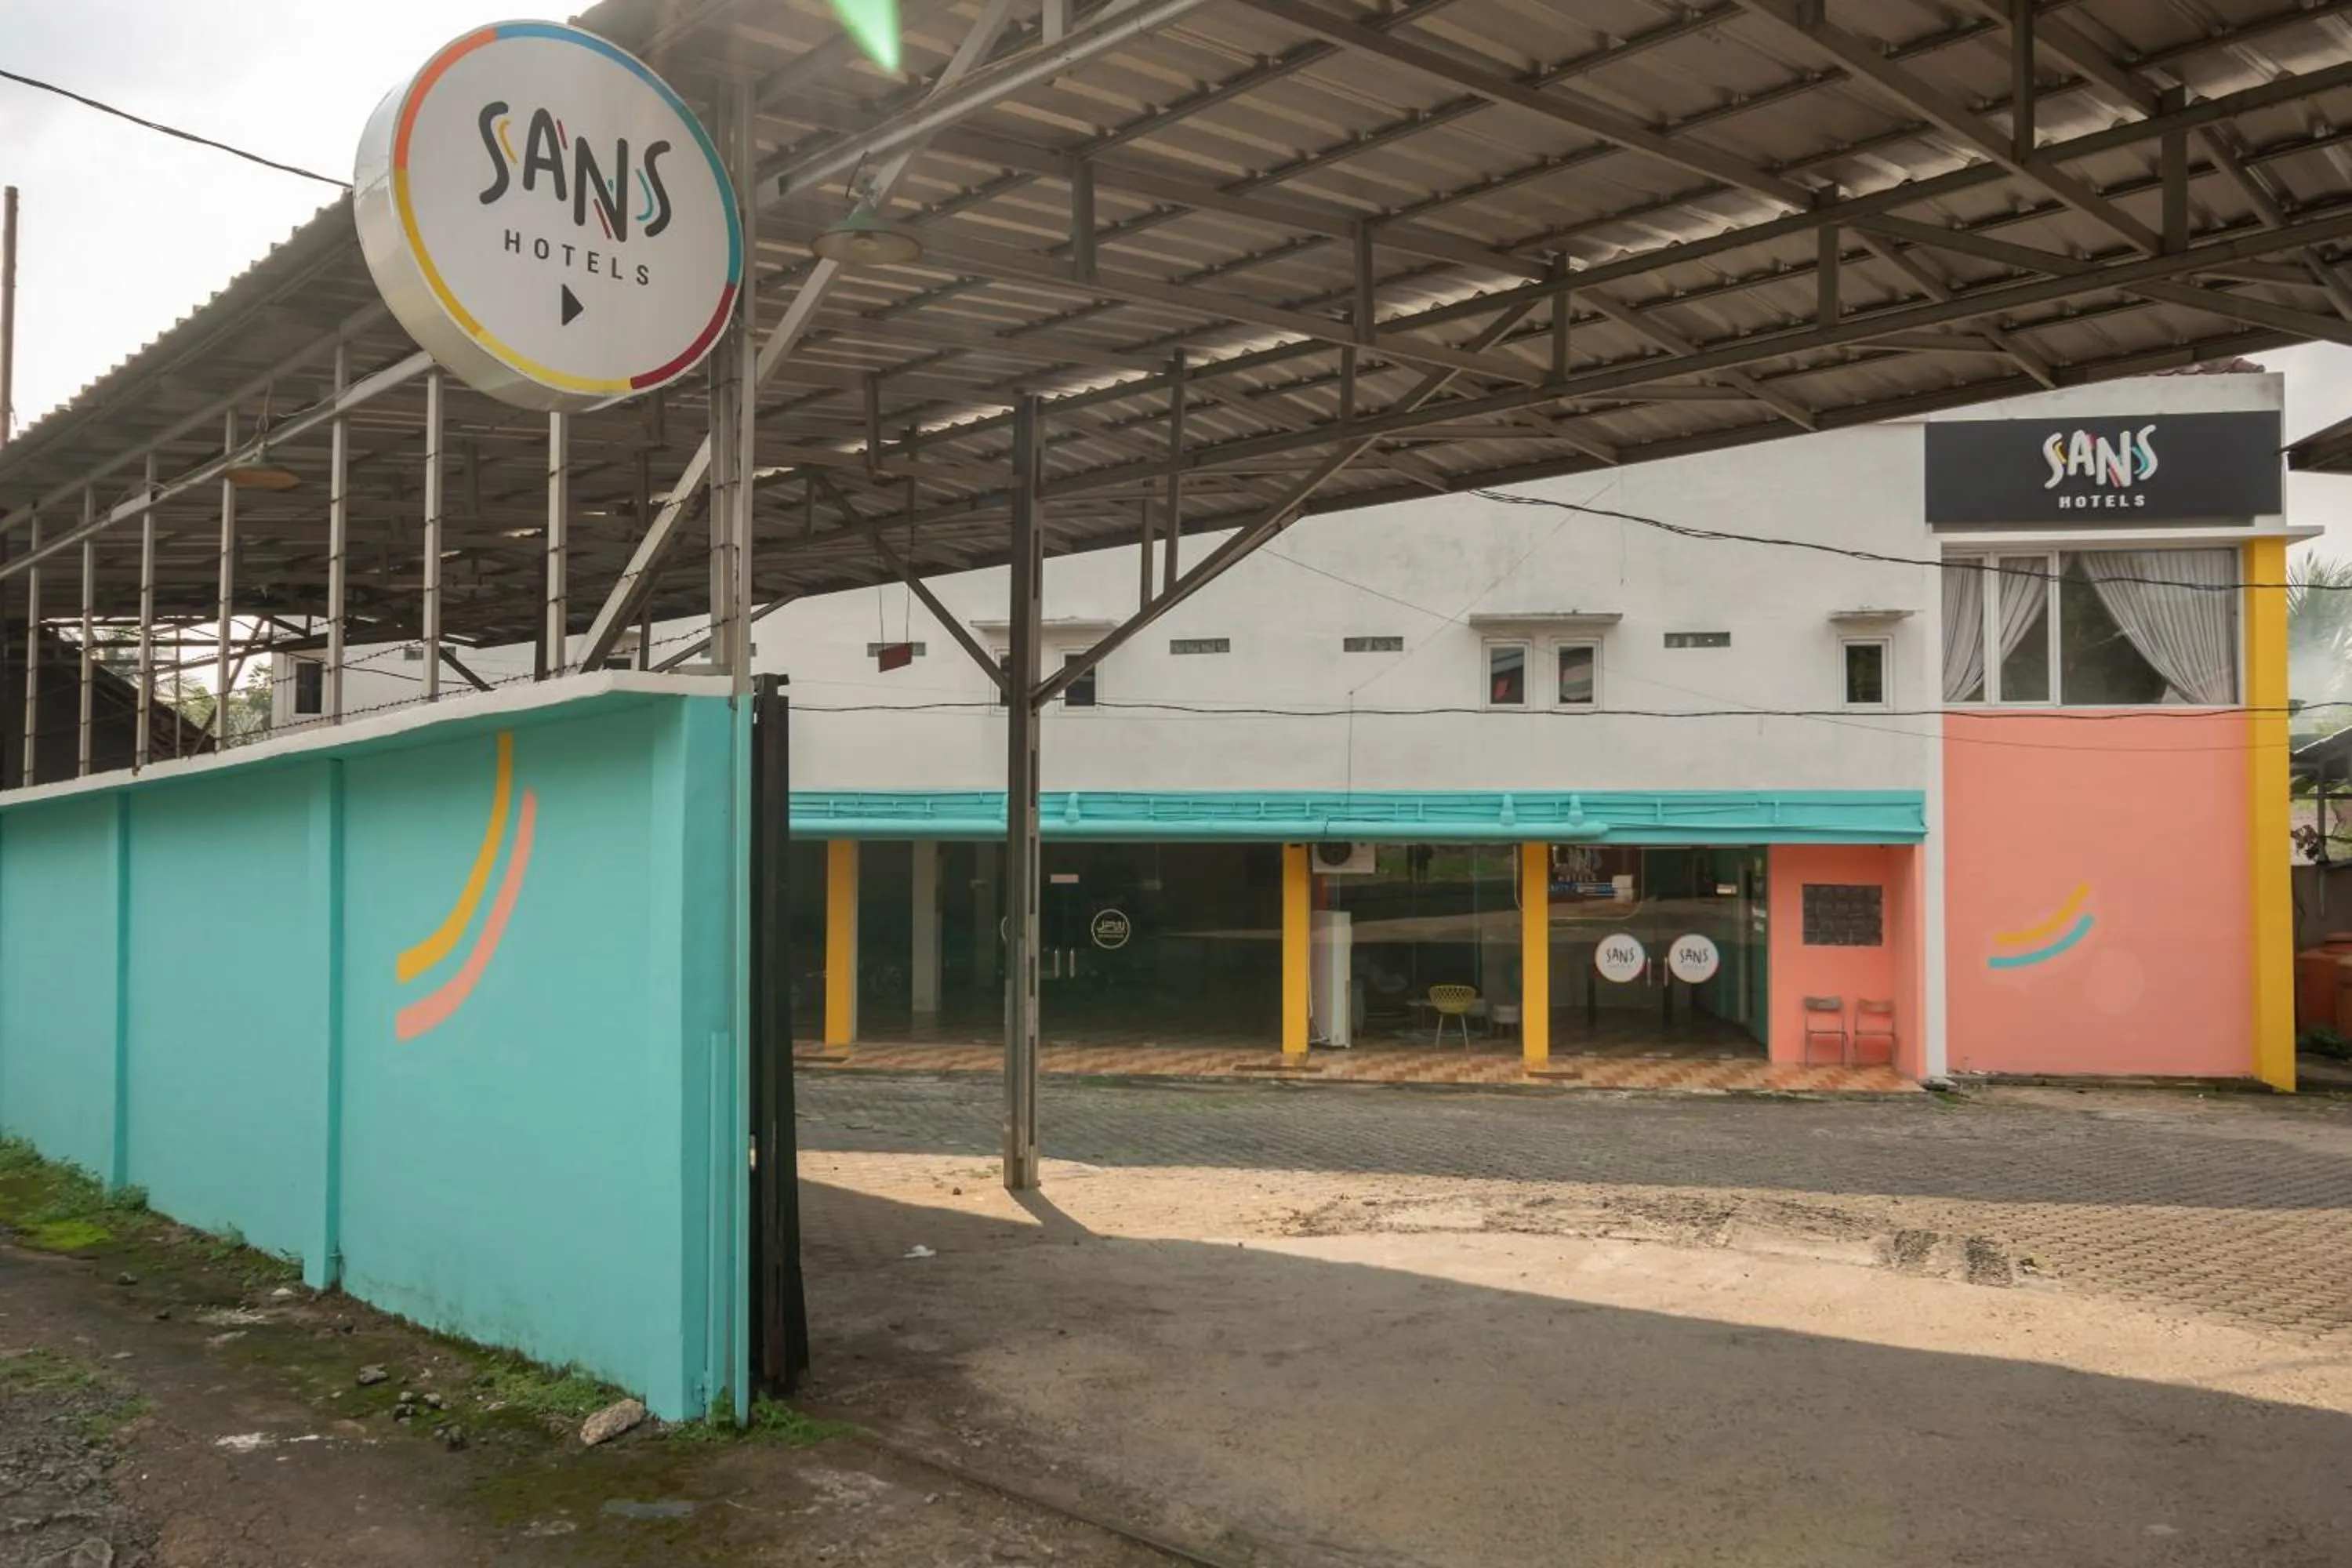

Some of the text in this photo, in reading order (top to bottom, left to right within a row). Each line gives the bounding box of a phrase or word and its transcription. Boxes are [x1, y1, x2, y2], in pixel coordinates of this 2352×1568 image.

[478, 101, 672, 242] SANS
[504, 229, 650, 286] HOTELS
[2042, 424, 2158, 489] SANS
[2059, 495, 2146, 509] HOTELS
[1606, 947, 1635, 964] SANS
[1679, 948, 1709, 964] SANS
